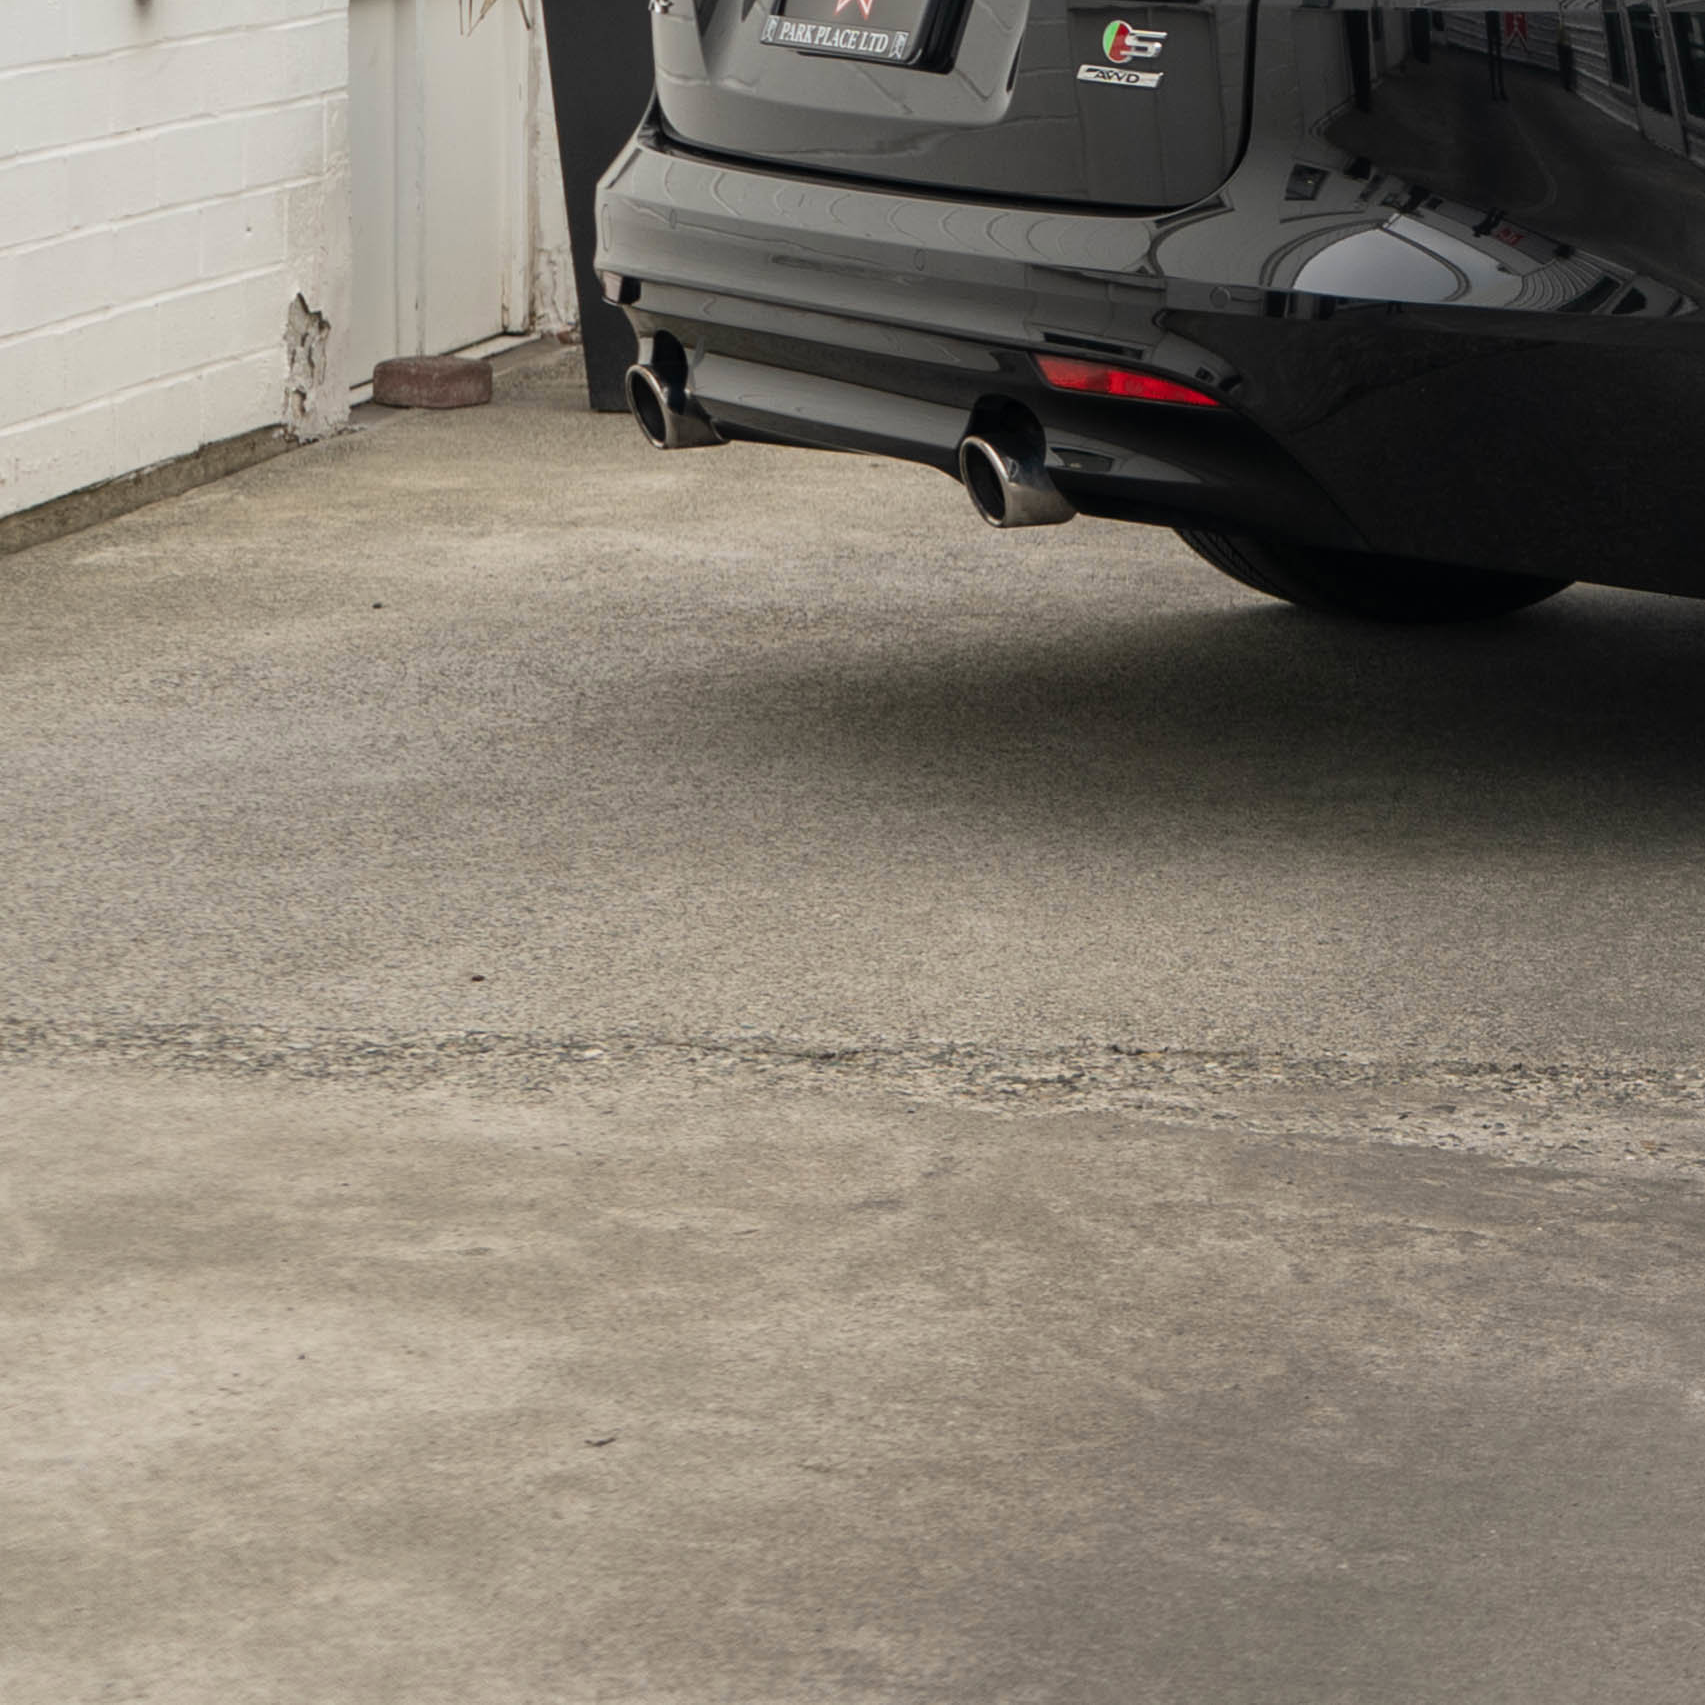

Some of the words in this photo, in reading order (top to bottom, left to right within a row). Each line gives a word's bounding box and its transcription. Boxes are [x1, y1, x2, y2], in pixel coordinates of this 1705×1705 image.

[779, 21, 816, 44] PARK
[814, 25, 860, 50] PLACE
[858, 31, 889, 54] LTD
[1093, 68, 1141, 84] AWD
